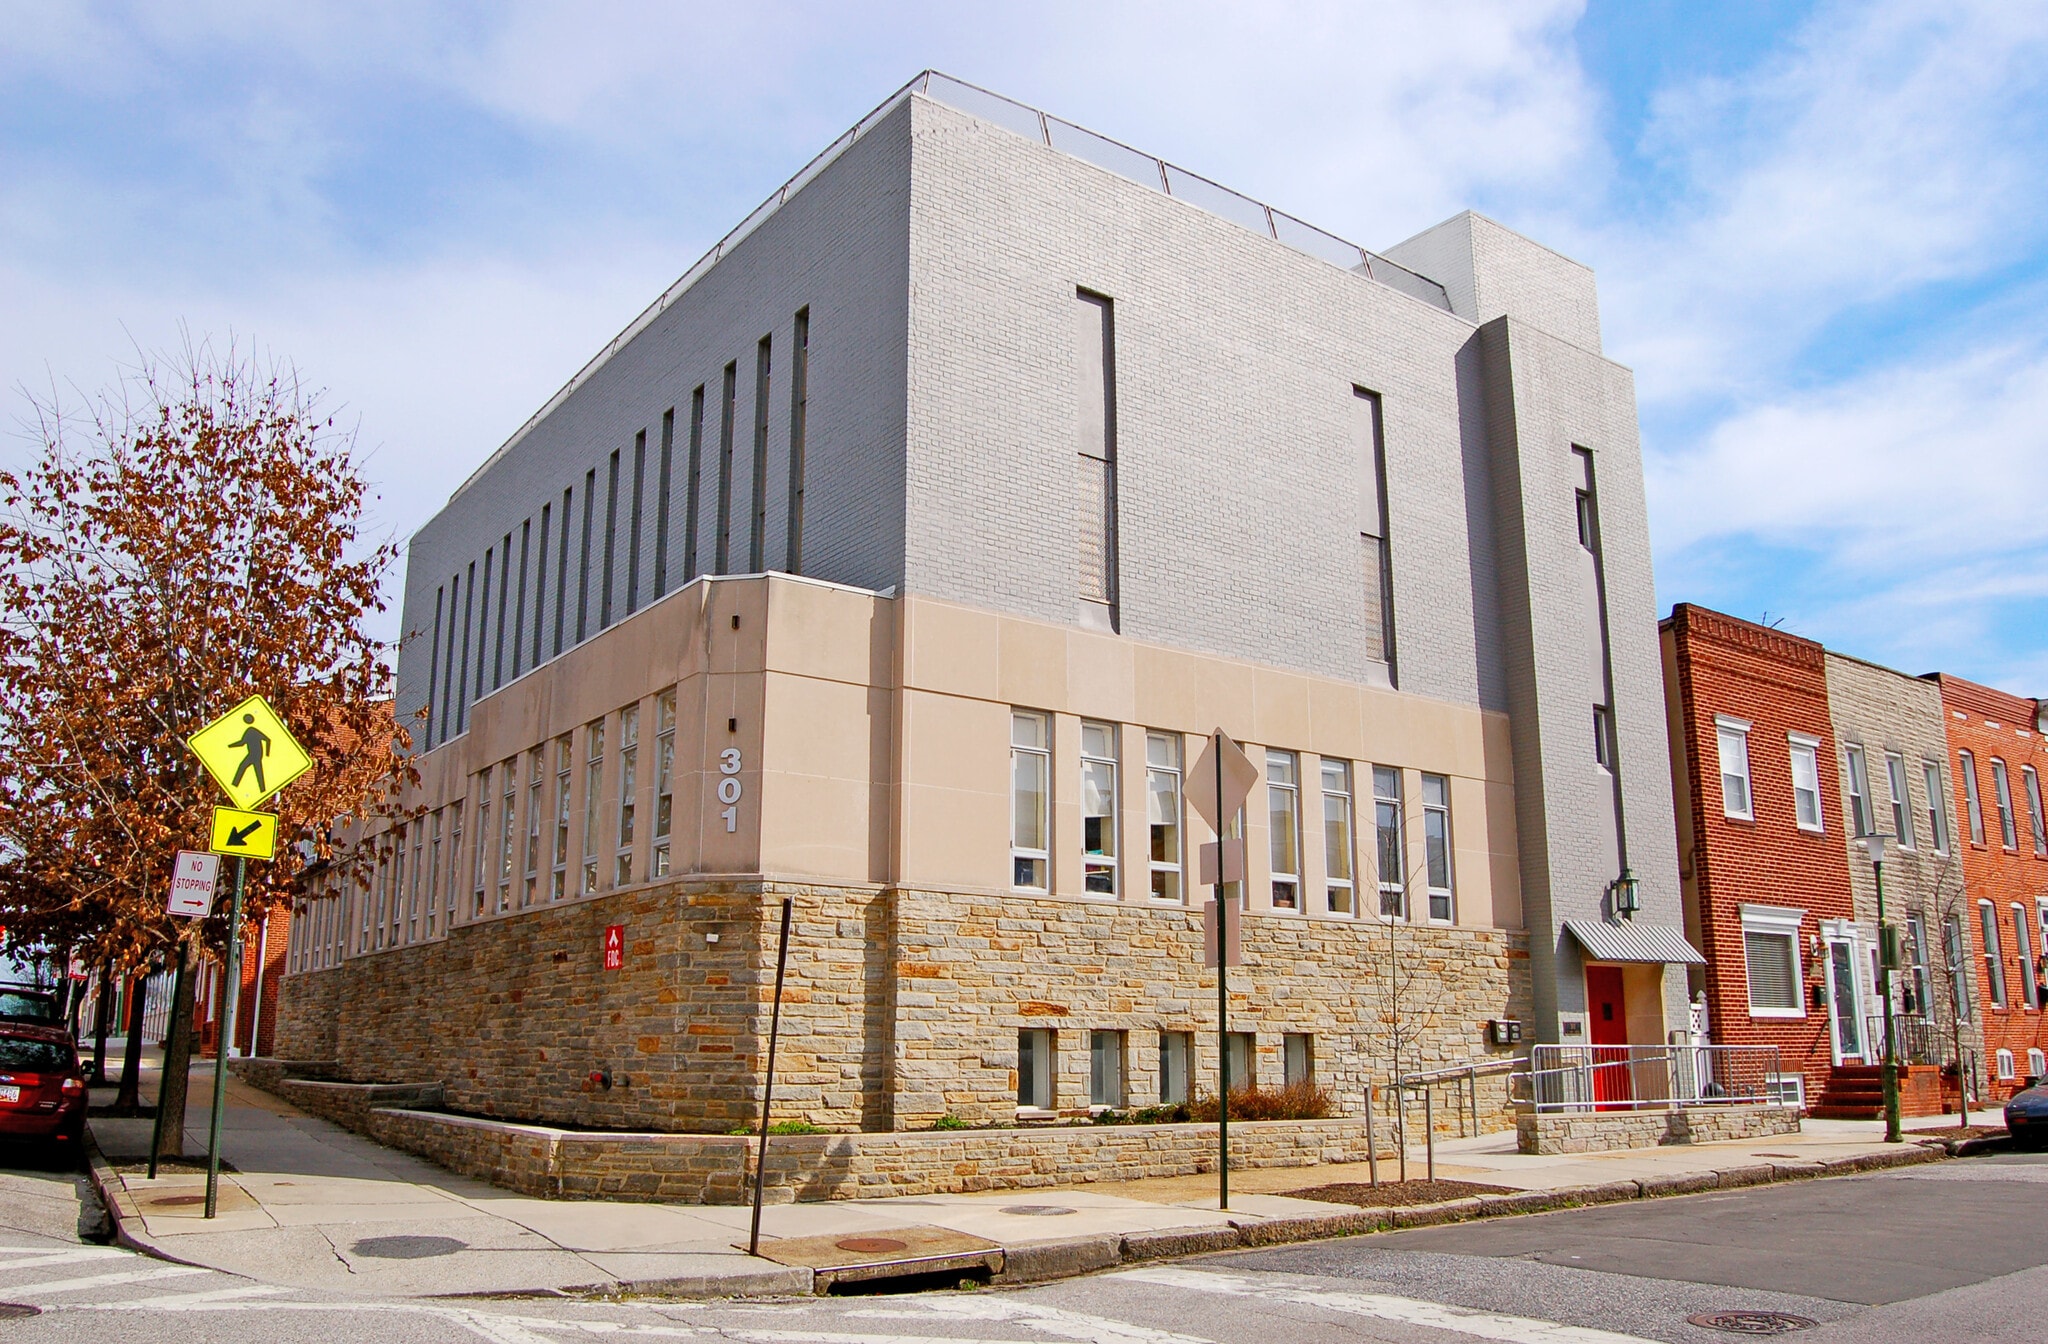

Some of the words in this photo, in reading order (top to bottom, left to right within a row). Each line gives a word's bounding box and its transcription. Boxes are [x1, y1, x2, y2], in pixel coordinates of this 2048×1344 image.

[718, 748, 742, 832] 301
[191, 860, 203, 872] NO
[176, 877, 211, 892] STOPPING
